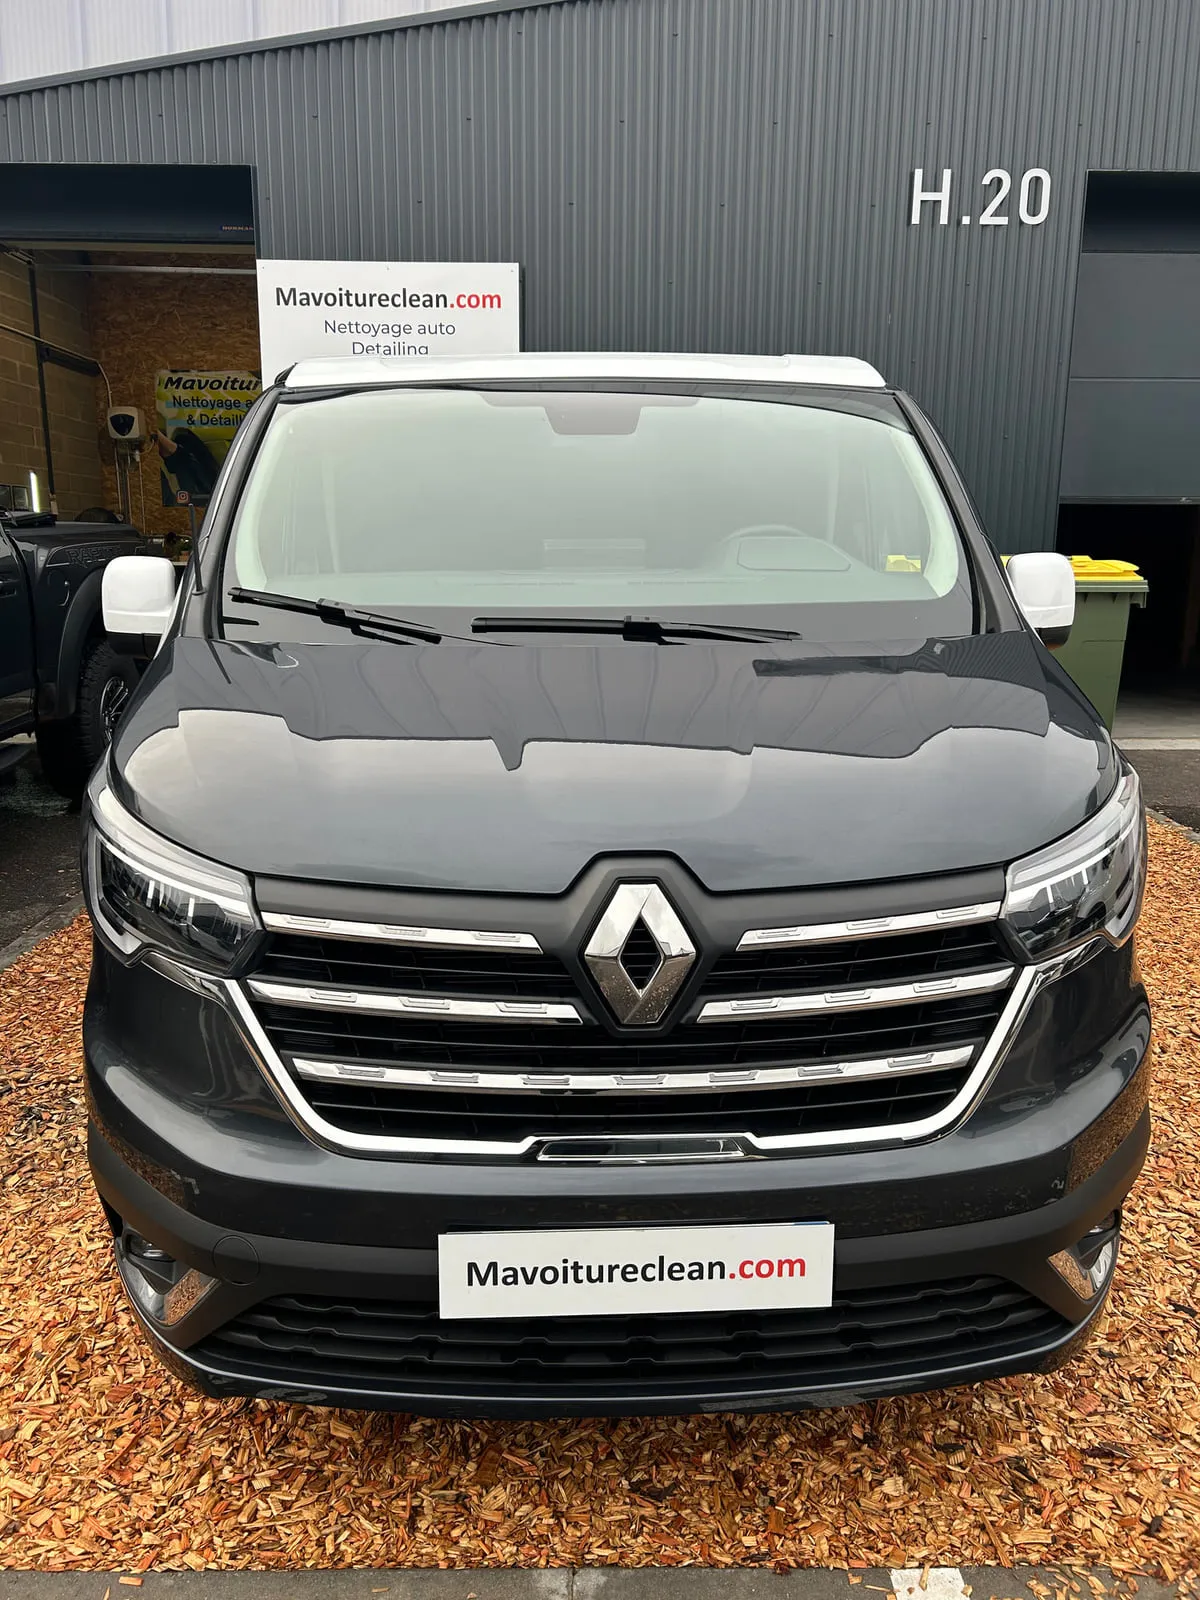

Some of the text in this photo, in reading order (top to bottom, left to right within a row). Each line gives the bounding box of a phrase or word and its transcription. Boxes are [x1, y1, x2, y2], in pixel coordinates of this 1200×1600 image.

[911, 167, 1051, 225] H.20
[275, 286, 502, 309] Mavoitureclean.com
[324, 319, 456, 338] Nettoyage auto
[172, 395, 242, 410] Nettoyage
[186, 414, 196, 425] &
[466, 1255, 807, 1287] Mavoitureclean.com
